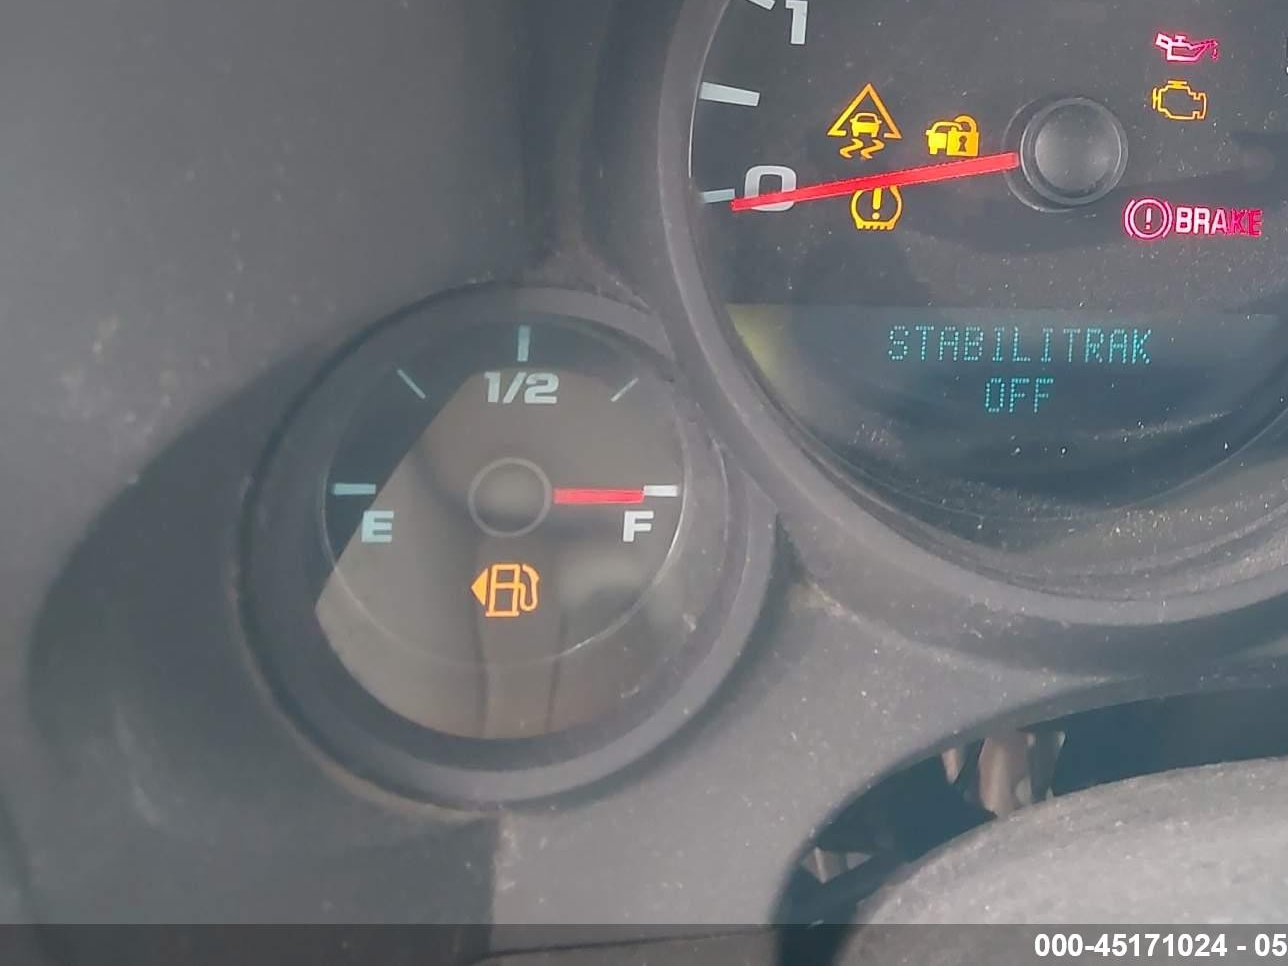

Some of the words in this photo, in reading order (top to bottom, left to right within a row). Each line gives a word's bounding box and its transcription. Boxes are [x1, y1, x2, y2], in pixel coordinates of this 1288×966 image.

[785, 0, 808, 45] 1
[744, 165, 798, 213] 0
[1175, 207, 1263, 237] BRAKE
[887, 325, 1153, 365] STABILITRAK
[484, 371, 560, 405] 1/2
[984, 377, 1055, 414] OFF
[361, 510, 395, 543] E
[622, 510, 655, 543] F
